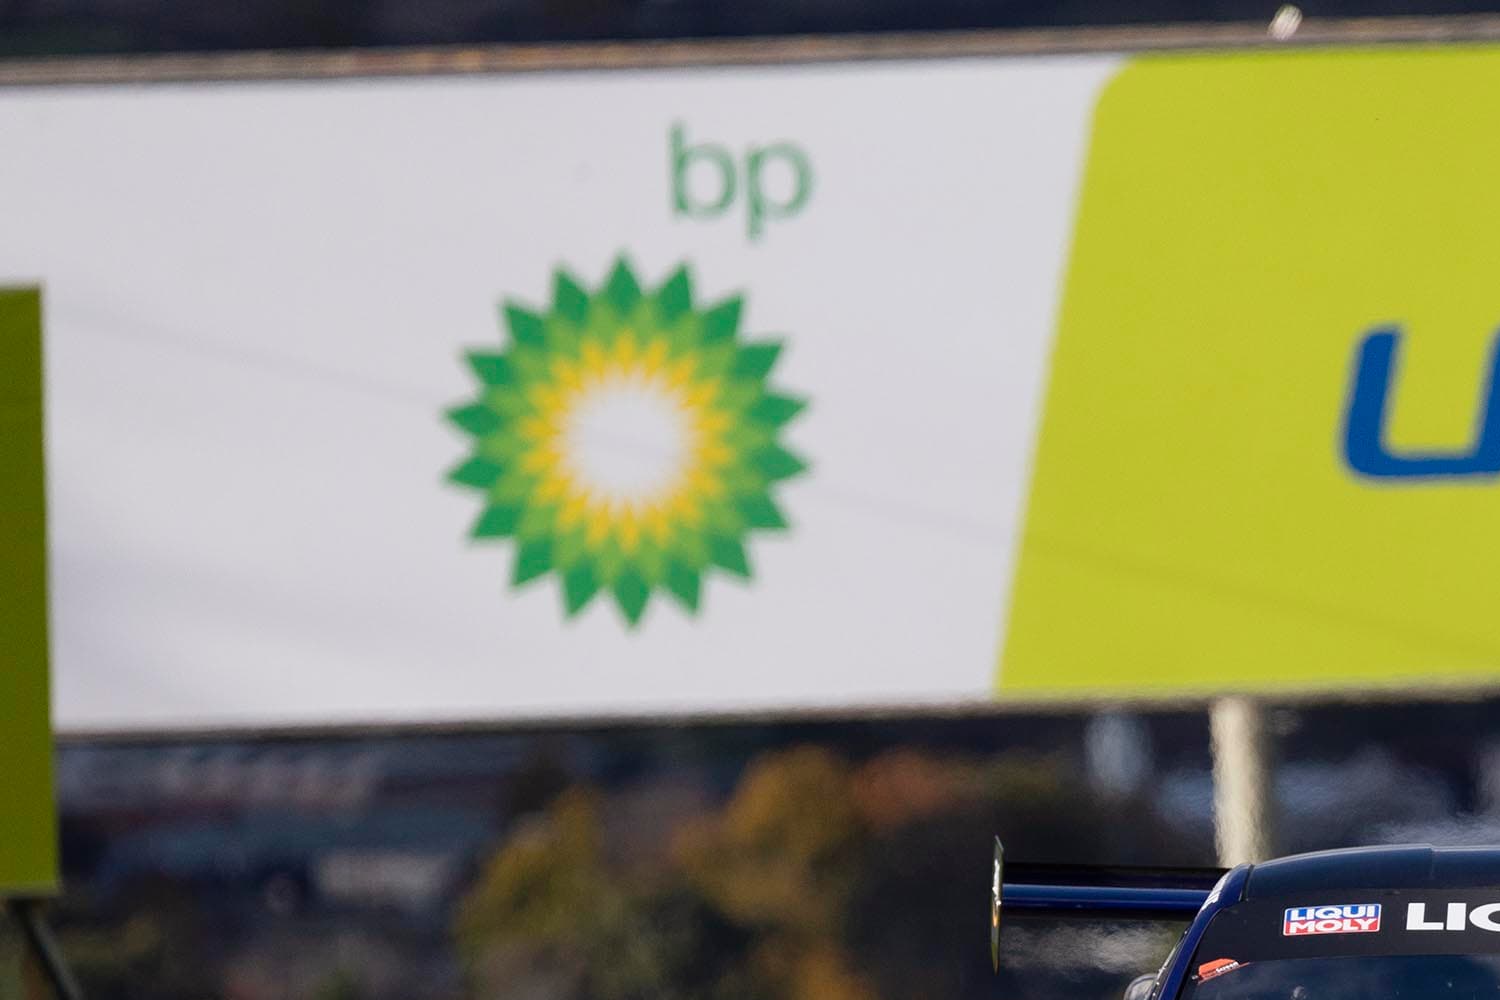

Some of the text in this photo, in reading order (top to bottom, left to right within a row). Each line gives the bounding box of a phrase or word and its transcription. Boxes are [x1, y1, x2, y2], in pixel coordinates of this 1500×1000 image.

[669, 121, 814, 241] bp
[1291, 904, 1376, 921] LIQUI
[1289, 917, 1378, 934] MOLY
